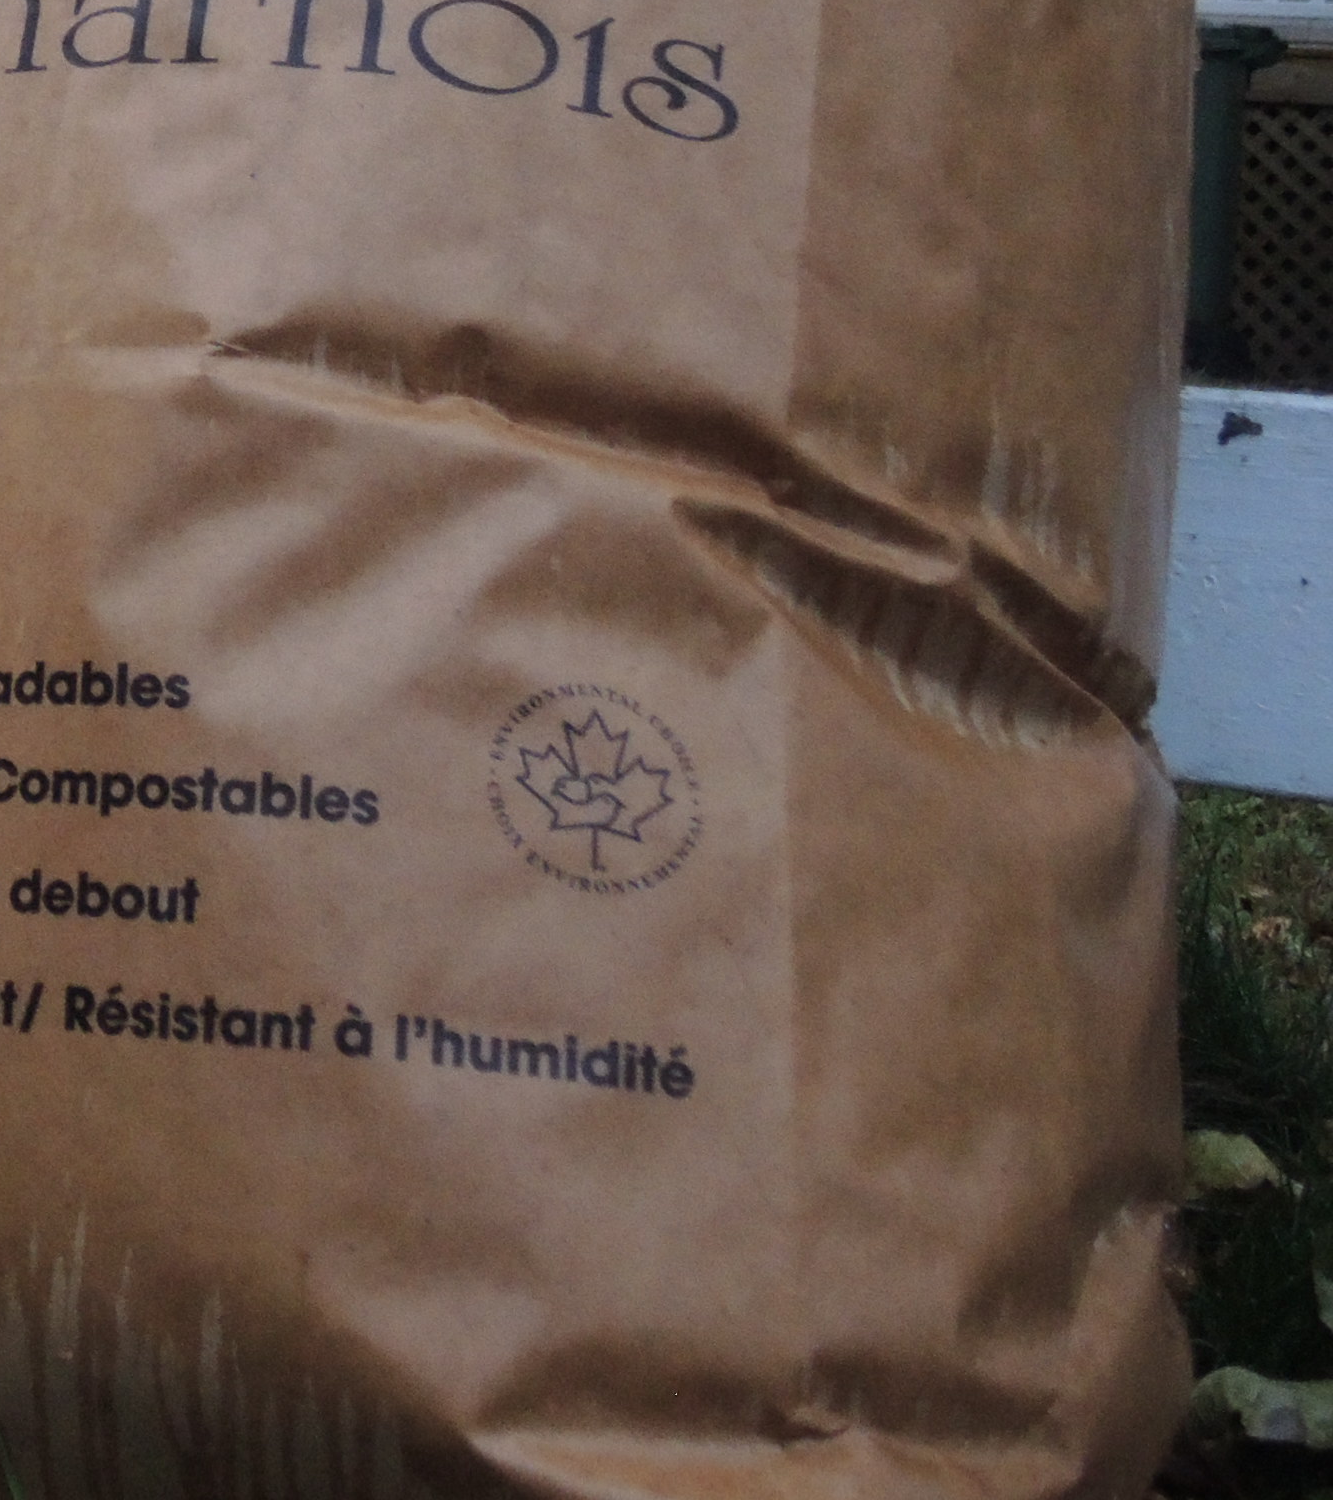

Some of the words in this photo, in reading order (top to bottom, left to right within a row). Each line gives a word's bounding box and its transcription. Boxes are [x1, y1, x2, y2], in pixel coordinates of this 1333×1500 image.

[10, 869, 201, 924] debout
[64, 985, 316, 1052] Résistant
[334, 1004, 373, 1060] à
[395, 1014, 696, 1100] l'humidité
